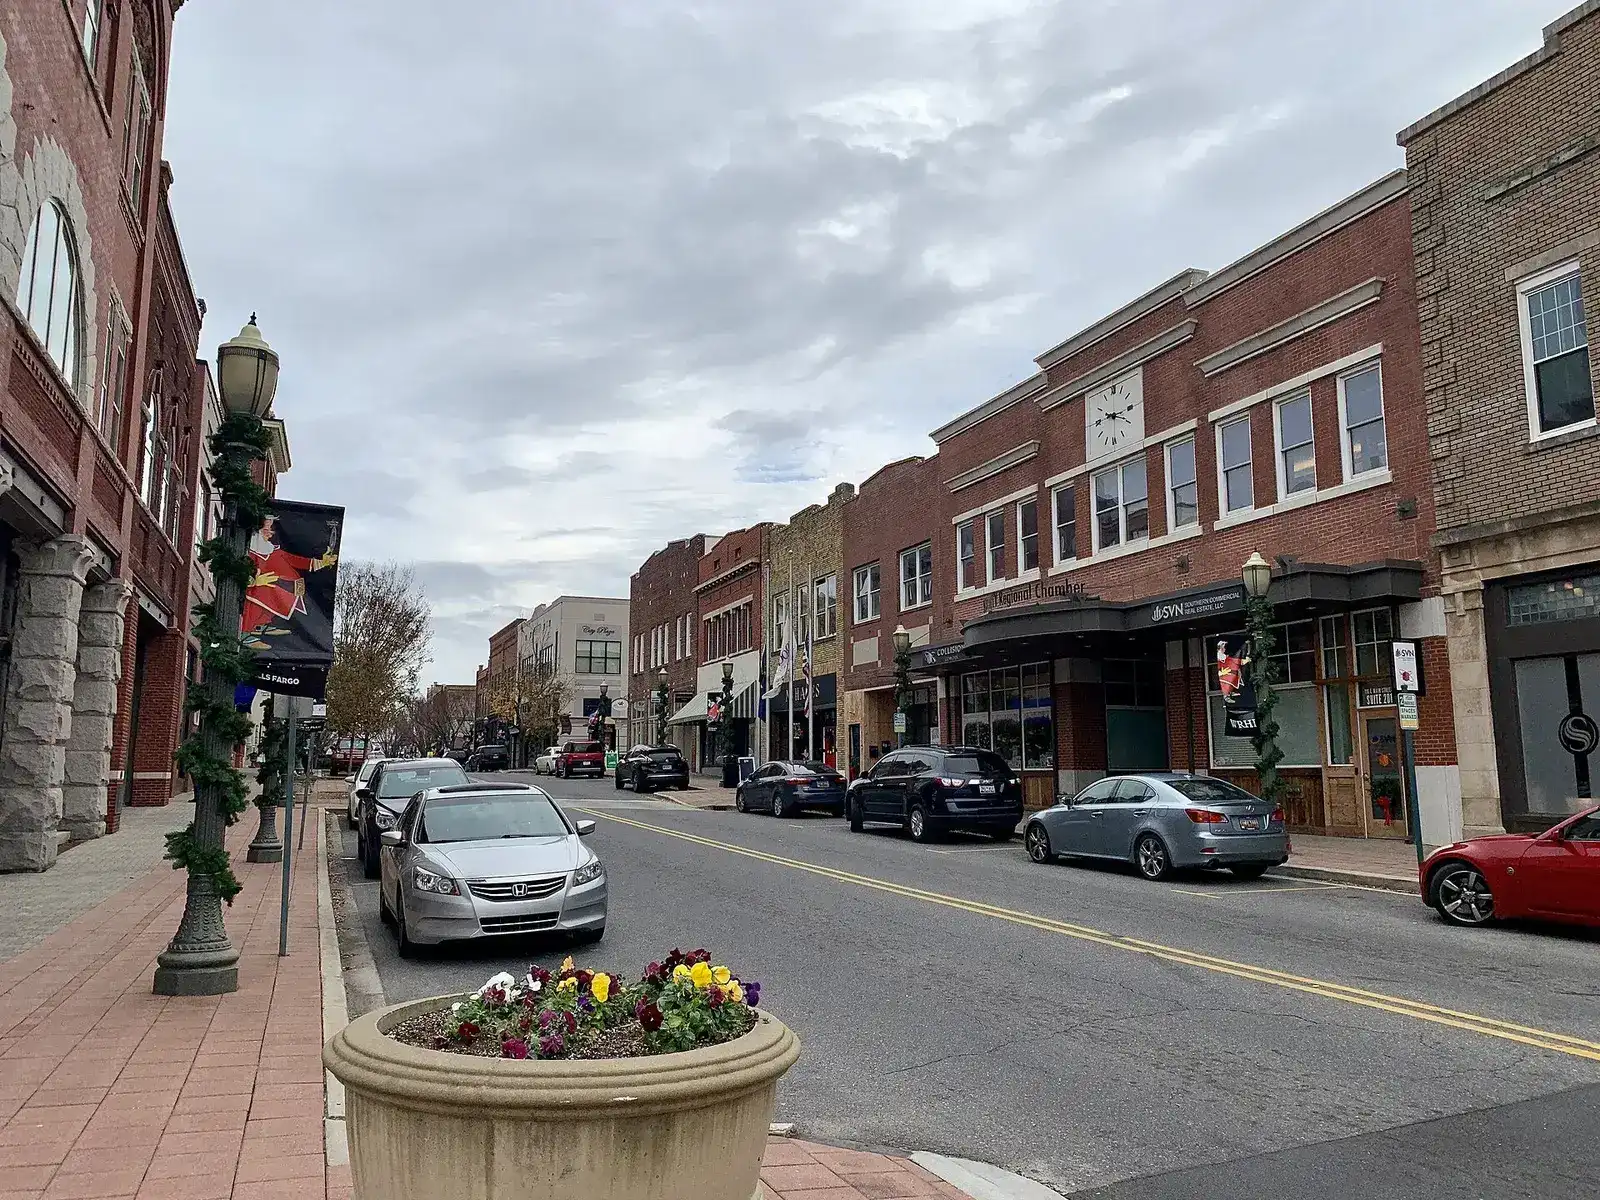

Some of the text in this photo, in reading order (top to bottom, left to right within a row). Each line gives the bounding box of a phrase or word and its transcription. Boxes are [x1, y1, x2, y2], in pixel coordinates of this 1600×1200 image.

[1000, 583, 1031, 607] Regional
[1035, 578, 1085, 599] Chamber
[1163, 592, 1240, 619] SVN SOUTHERN COMMERCIAL
[1184, 606, 1196, 615] REAL
[1401, 649, 1415, 657] SVN
[272, 675, 300, 685] FARGO
[1366, 694, 1382, 705] SUITE
[1229, 718, 1257, 729] WRHI
